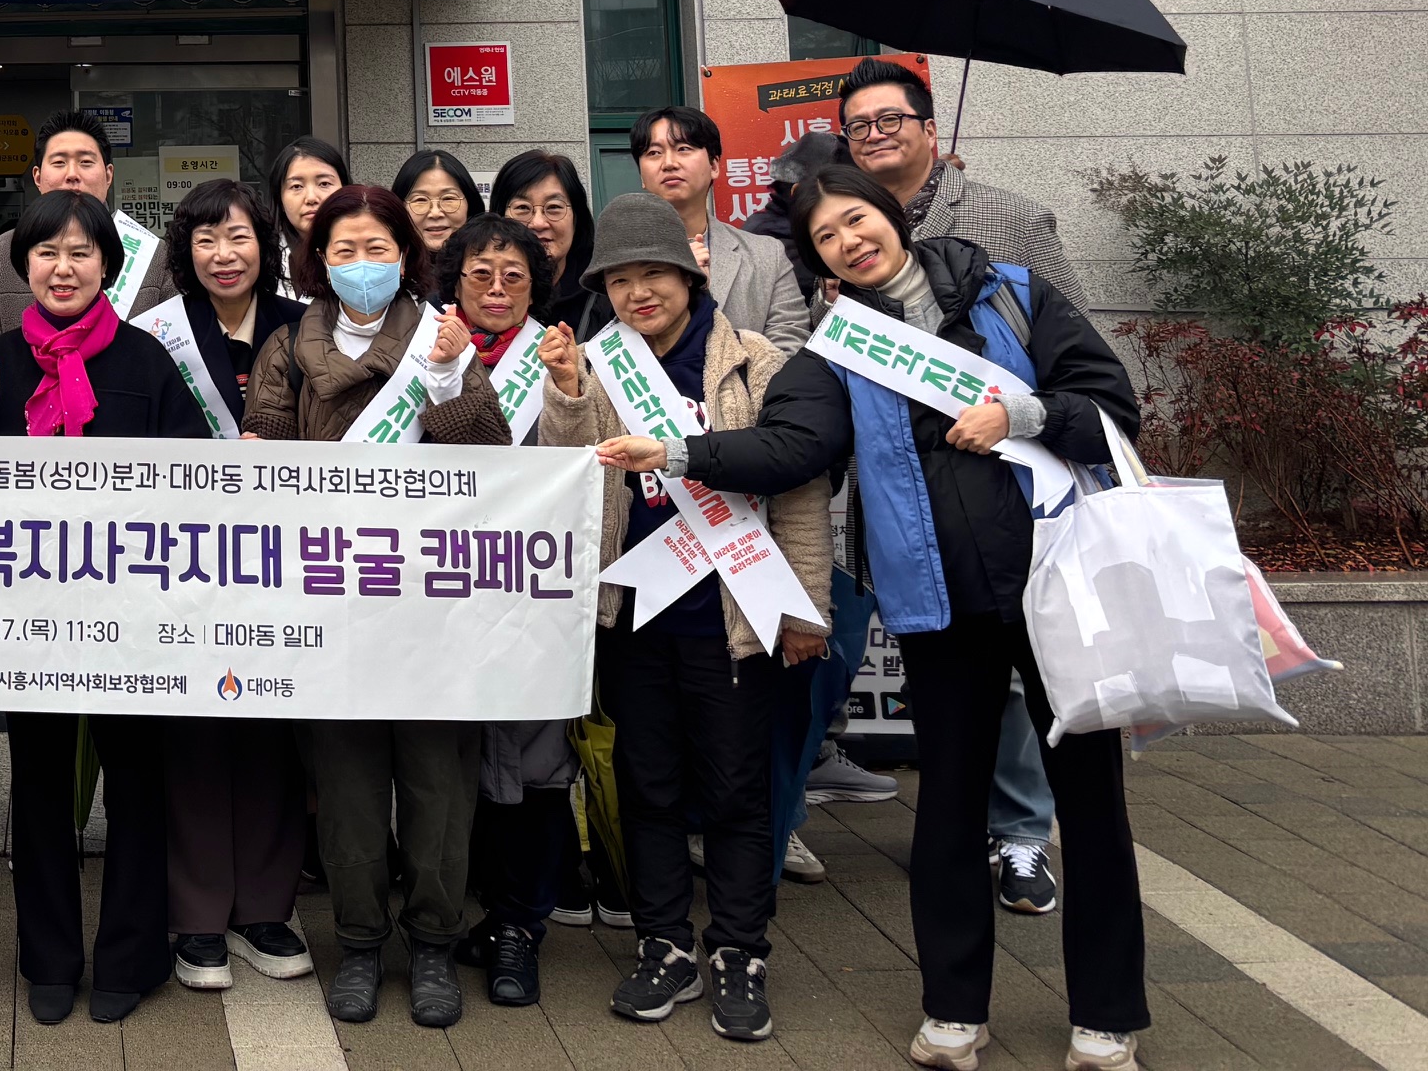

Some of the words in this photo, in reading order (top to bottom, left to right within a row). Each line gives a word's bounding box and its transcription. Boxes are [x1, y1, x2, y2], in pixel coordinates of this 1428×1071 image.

[444, 66, 497, 86] 에스원
[433, 107, 472, 118] SECOM
[181, 160, 219, 170] 운영시간
[166, 180, 192, 189] 09:00
[824, 314, 987, 406] 복지사각지대
[252, 465, 478, 499] 지역사회보장협의체
[299, 525, 406, 597] 발굴
[420, 527, 575, 600] 캠페인
[66, 620, 120, 643] 11:30
[157, 623, 196, 645] 장소
[214, 623, 276, 647] 대야동
[282, 624, 323, 648] 일대
[247, 677, 296, 698] 대야동
